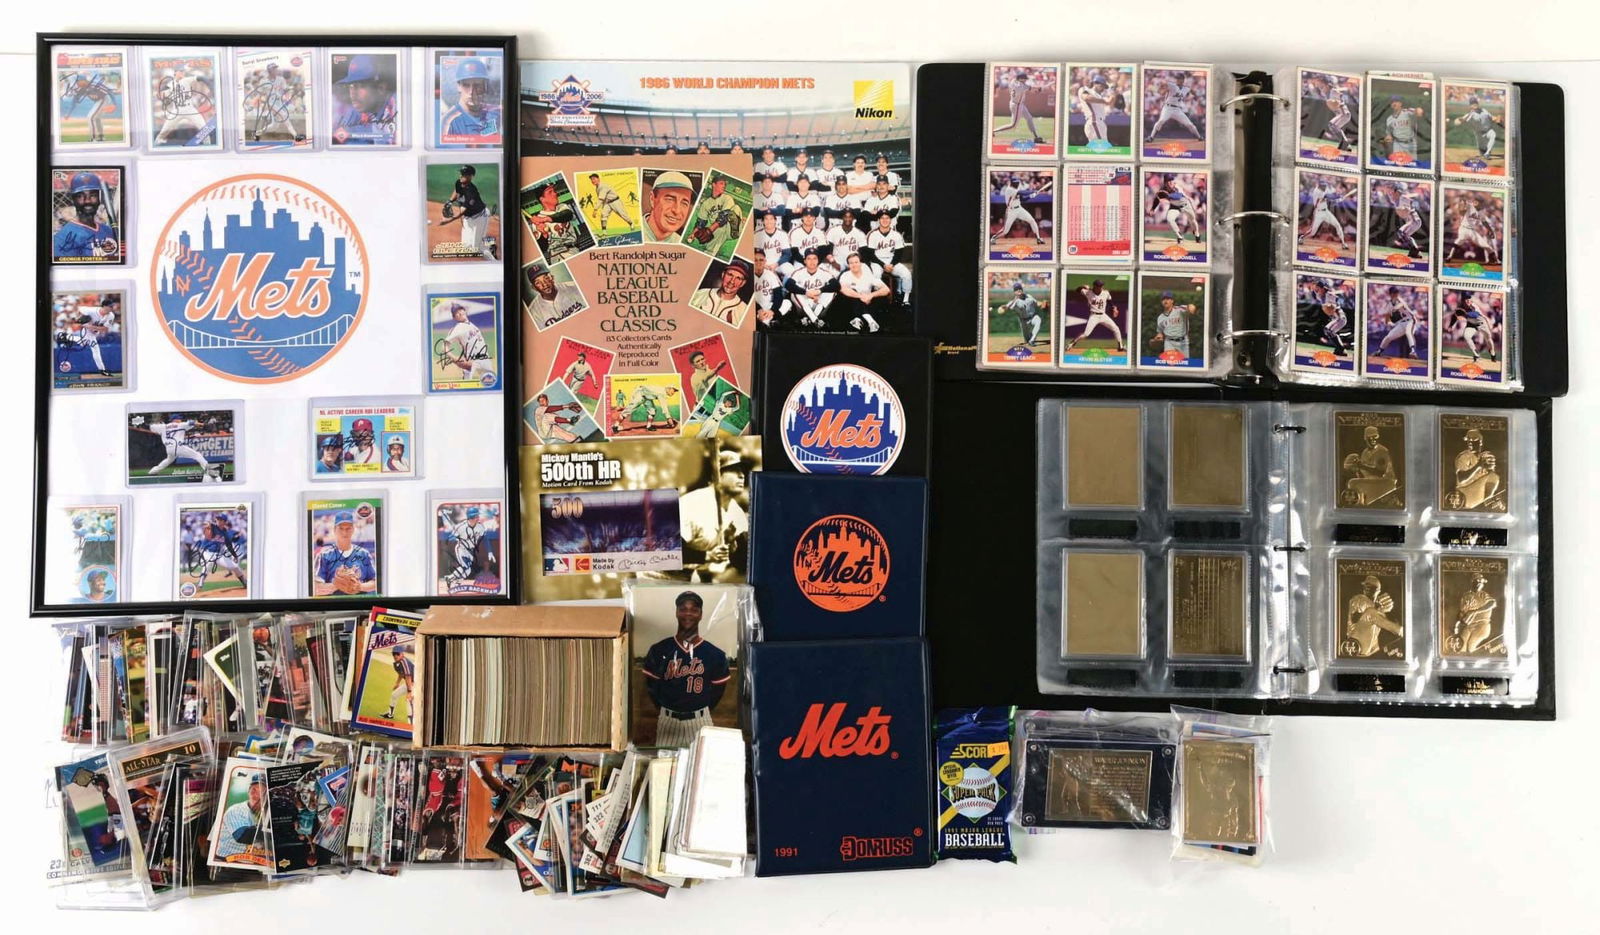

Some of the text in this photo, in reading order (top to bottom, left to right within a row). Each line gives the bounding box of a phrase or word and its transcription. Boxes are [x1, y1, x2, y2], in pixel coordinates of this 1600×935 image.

[640, 77, 815, 89] 1986 WORLD CHAMPION METS
[855, 107, 892, 118] Nikon
[590, 251, 686, 262] Bert Randolph Sugar
[597, 263, 678, 276] NATIONAL
[184, 252, 335, 321] Mets
[606, 277, 669, 290] LEAGUE
[597, 291, 679, 304] BASEBALL
[615, 305, 662, 318] CARD
[600, 320, 678, 332] CLASSICS
[801, 409, 884, 448] Mets
[541, 452, 604, 463] Mickey Mantle's
[541, 460, 622, 482] 500th HR
[551, 497, 584, 520] 500
[808, 551, 874, 584] Mets
[371, 632, 398, 649] Mets
[664, 657, 706, 681] Mets
[686, 677, 704, 694] 18
[779, 703, 892, 760] Mets
[126, 744, 196, 773] ALL-STAR 10
[950, 744, 989, 759] SCOR
[950, 784, 996, 804] SUPER PACK
[944, 832, 1005, 847] BASEBALL
[775, 848, 798, 856] 1991
[840, 836, 914, 862] DONRUSS
